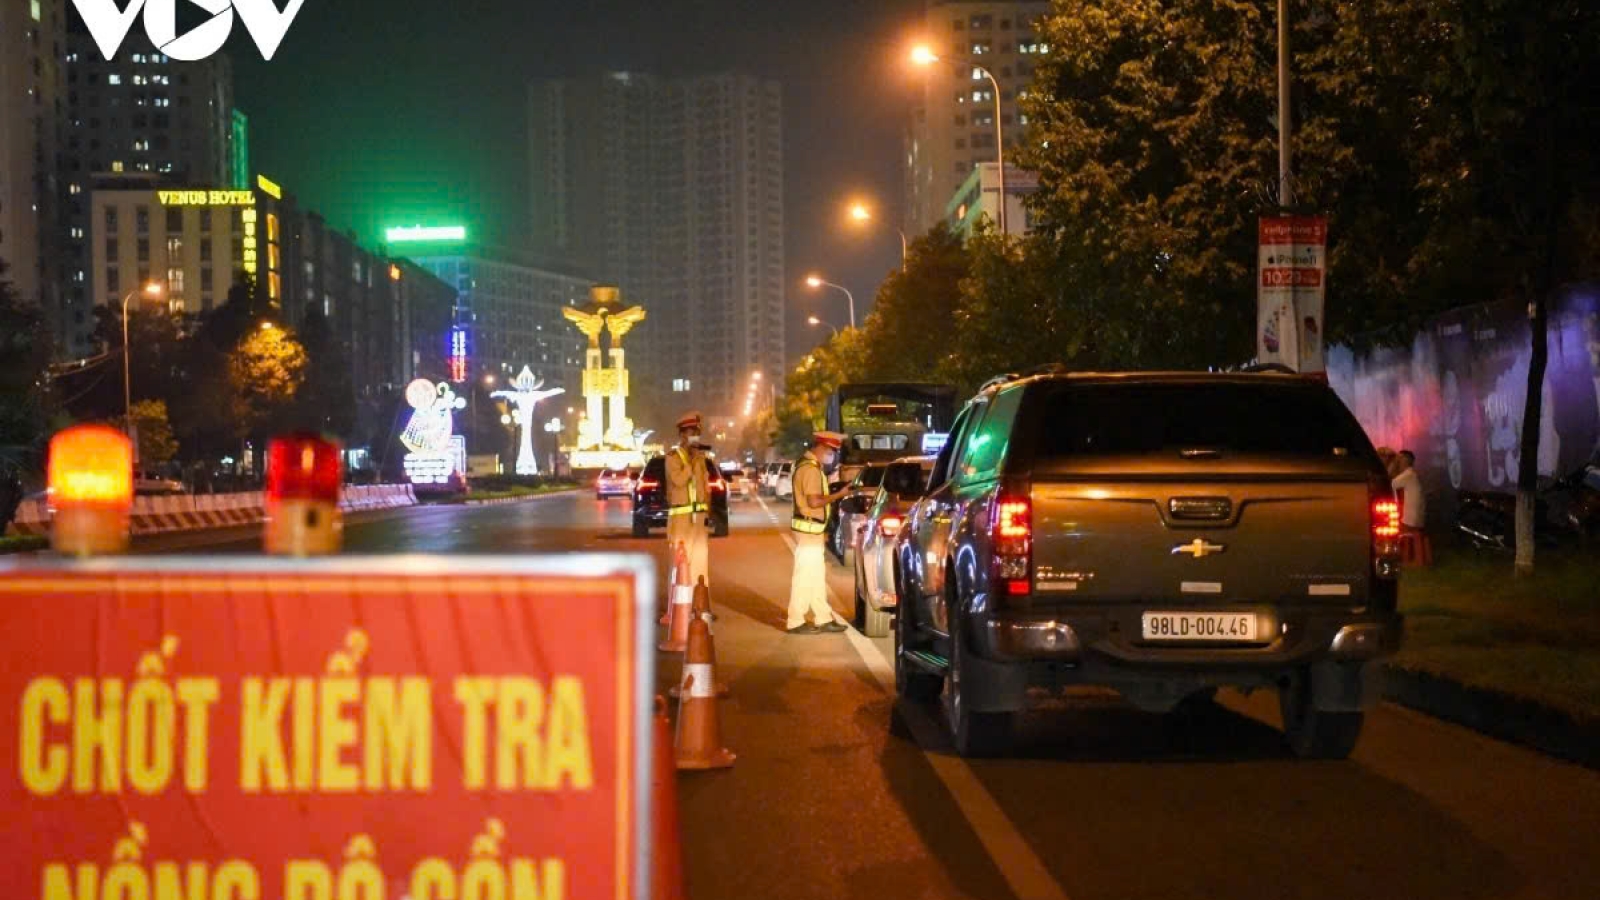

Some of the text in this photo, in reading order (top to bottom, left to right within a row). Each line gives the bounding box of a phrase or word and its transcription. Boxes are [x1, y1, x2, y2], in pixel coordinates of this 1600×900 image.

[158, 190, 256, 205] VENUS HOTEL
[1150, 617, 1249, 636] 98LD-004.46
[20, 630, 593, 795] CHỐT KIỂM TRA
